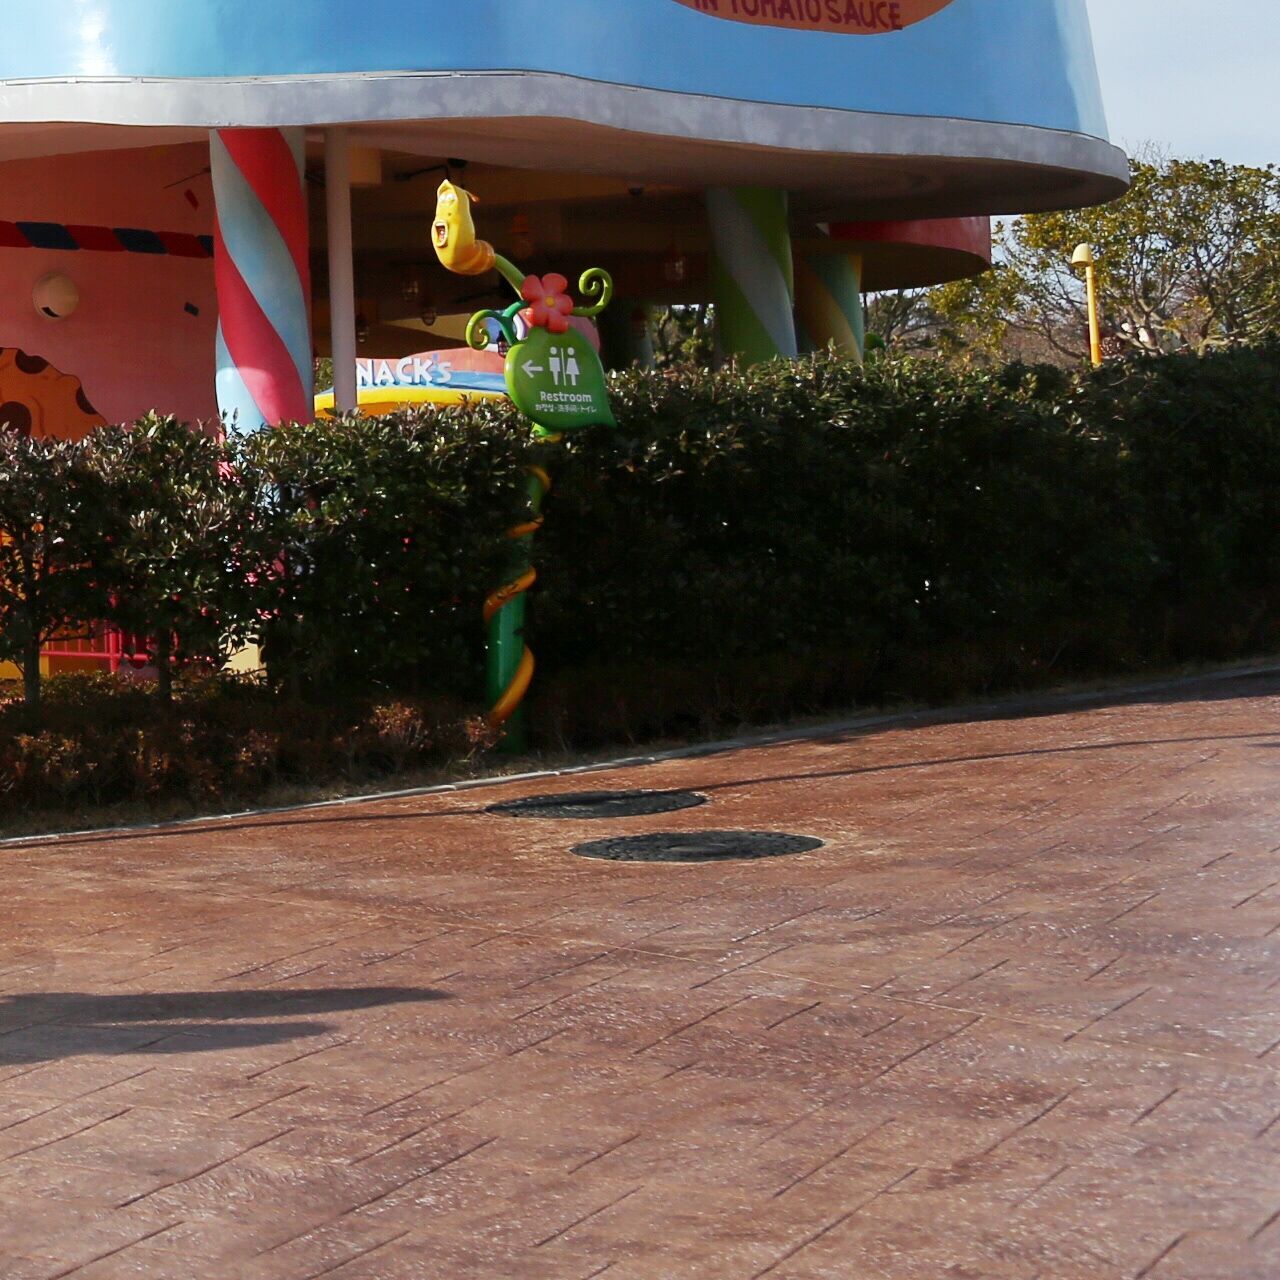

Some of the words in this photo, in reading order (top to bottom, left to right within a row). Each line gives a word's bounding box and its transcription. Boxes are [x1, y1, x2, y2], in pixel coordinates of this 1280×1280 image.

[825, 0, 904, 31] SAUCE
[356, 356, 452, 387] NACK'S
[540, 391, 592, 402] Restroom
